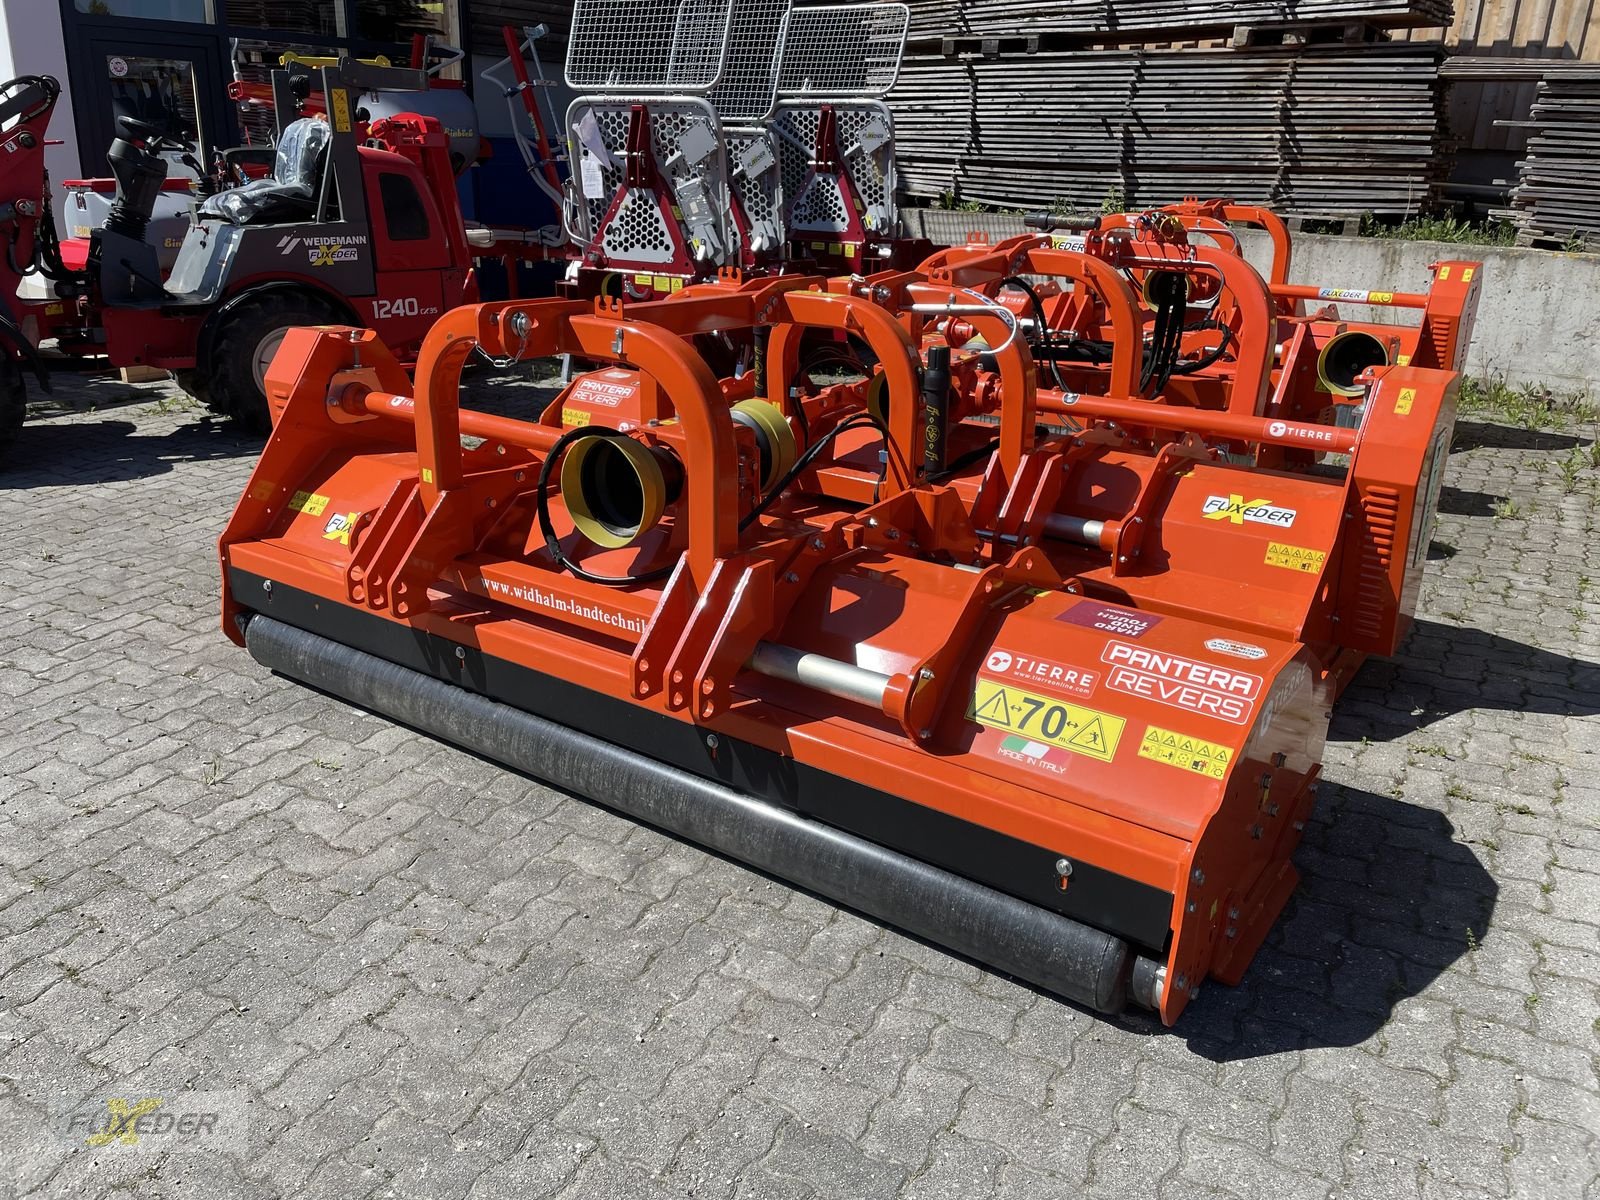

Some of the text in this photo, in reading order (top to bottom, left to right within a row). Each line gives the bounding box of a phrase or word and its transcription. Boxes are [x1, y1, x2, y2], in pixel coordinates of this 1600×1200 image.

[303, 235, 367, 246] WEIDEMANN
[372, 297, 418, 319] 1240
[573, 390, 620, 406] REVERS
[580, 380, 632, 397] PANTERA
[1287, 427, 1333, 441] TIERRE
[1094, 622, 1139, 636] HARD
[1097, 611, 1149, 628] TOUGH
[1110, 620, 1145, 631] AND
[1015, 657, 1094, 687] TIERRE
[1109, 644, 1253, 695] PANTERA
[1013, 671, 1090, 694] www.tierreonline.com
[1114, 670, 1244, 719] REVERS
[1017, 696, 1068, 739] 70
[997, 747, 1067, 774] MADE IN ITALY
